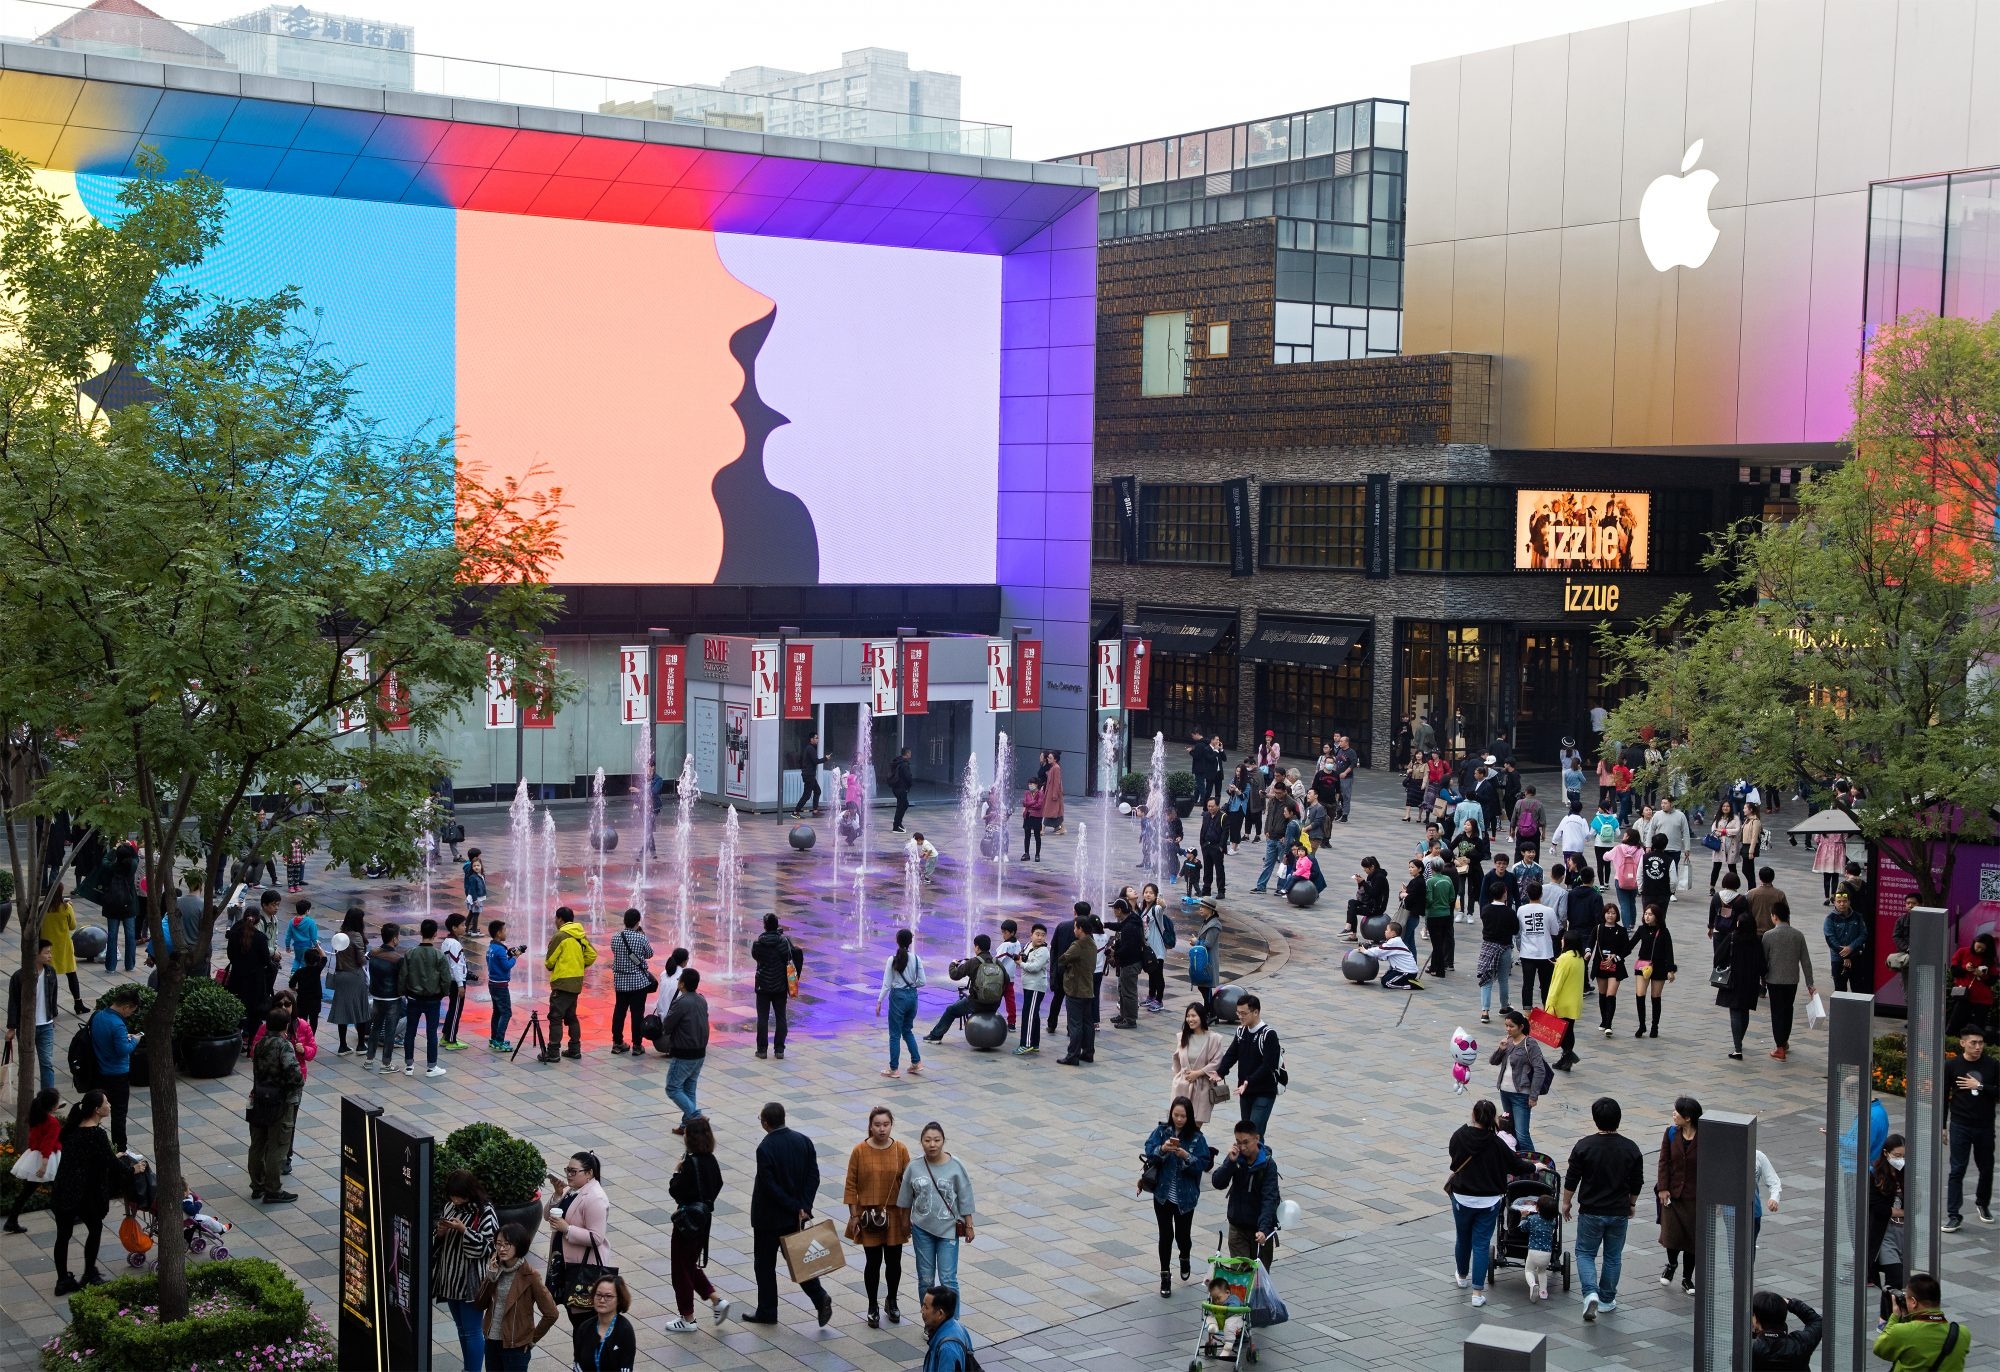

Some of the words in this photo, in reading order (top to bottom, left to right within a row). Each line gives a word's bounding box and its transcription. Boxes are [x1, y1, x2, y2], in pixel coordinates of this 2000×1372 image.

[1548, 513, 1619, 560] izzue
[1564, 577, 1620, 612] izzue
[1260, 629, 1349, 646] http://www.izzue.com
[703, 639, 728, 662] BMF
[1524, 913, 1534, 932] LAL
[1535, 912, 1544, 932] 1948
[803, 1248, 831, 1264] adidas
